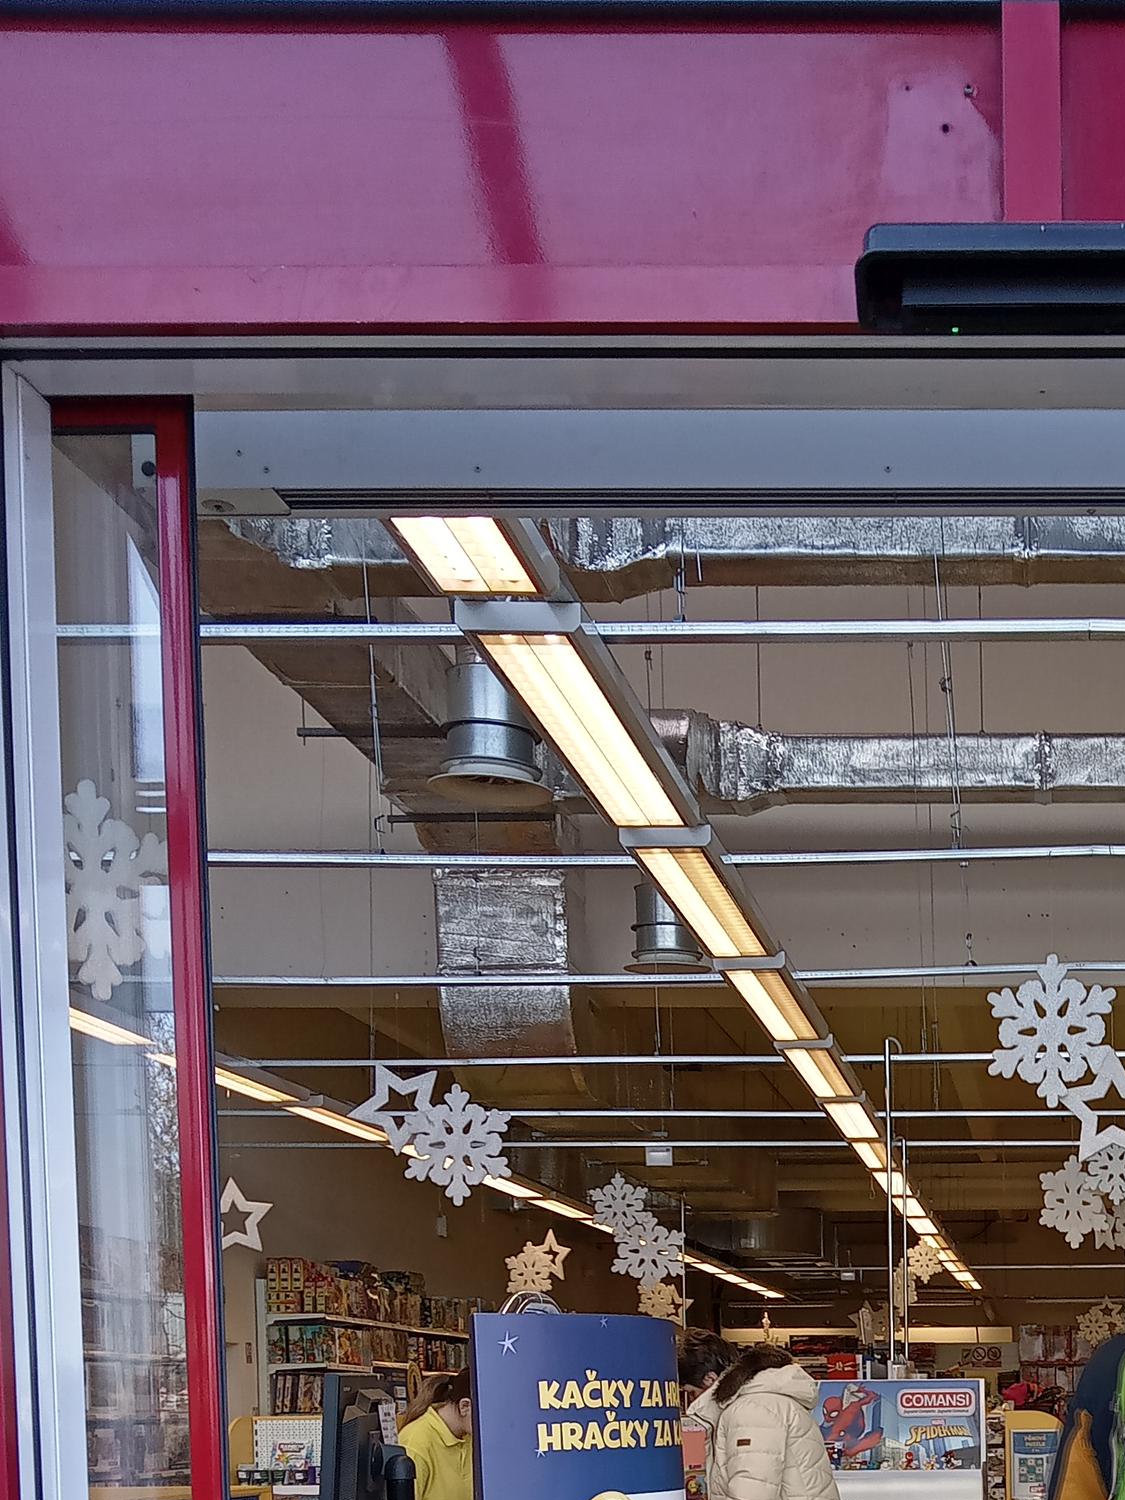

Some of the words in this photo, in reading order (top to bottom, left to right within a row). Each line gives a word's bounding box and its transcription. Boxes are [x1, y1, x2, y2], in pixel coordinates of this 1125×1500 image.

[538, 1369, 635, 1410] KAČKY
[640, 1380, 663, 1408] ZA
[902, 1393, 970, 1407] COMANSI
[537, 1410, 649, 1452] HRAČKY
[654, 1419, 673, 1447] ZA
